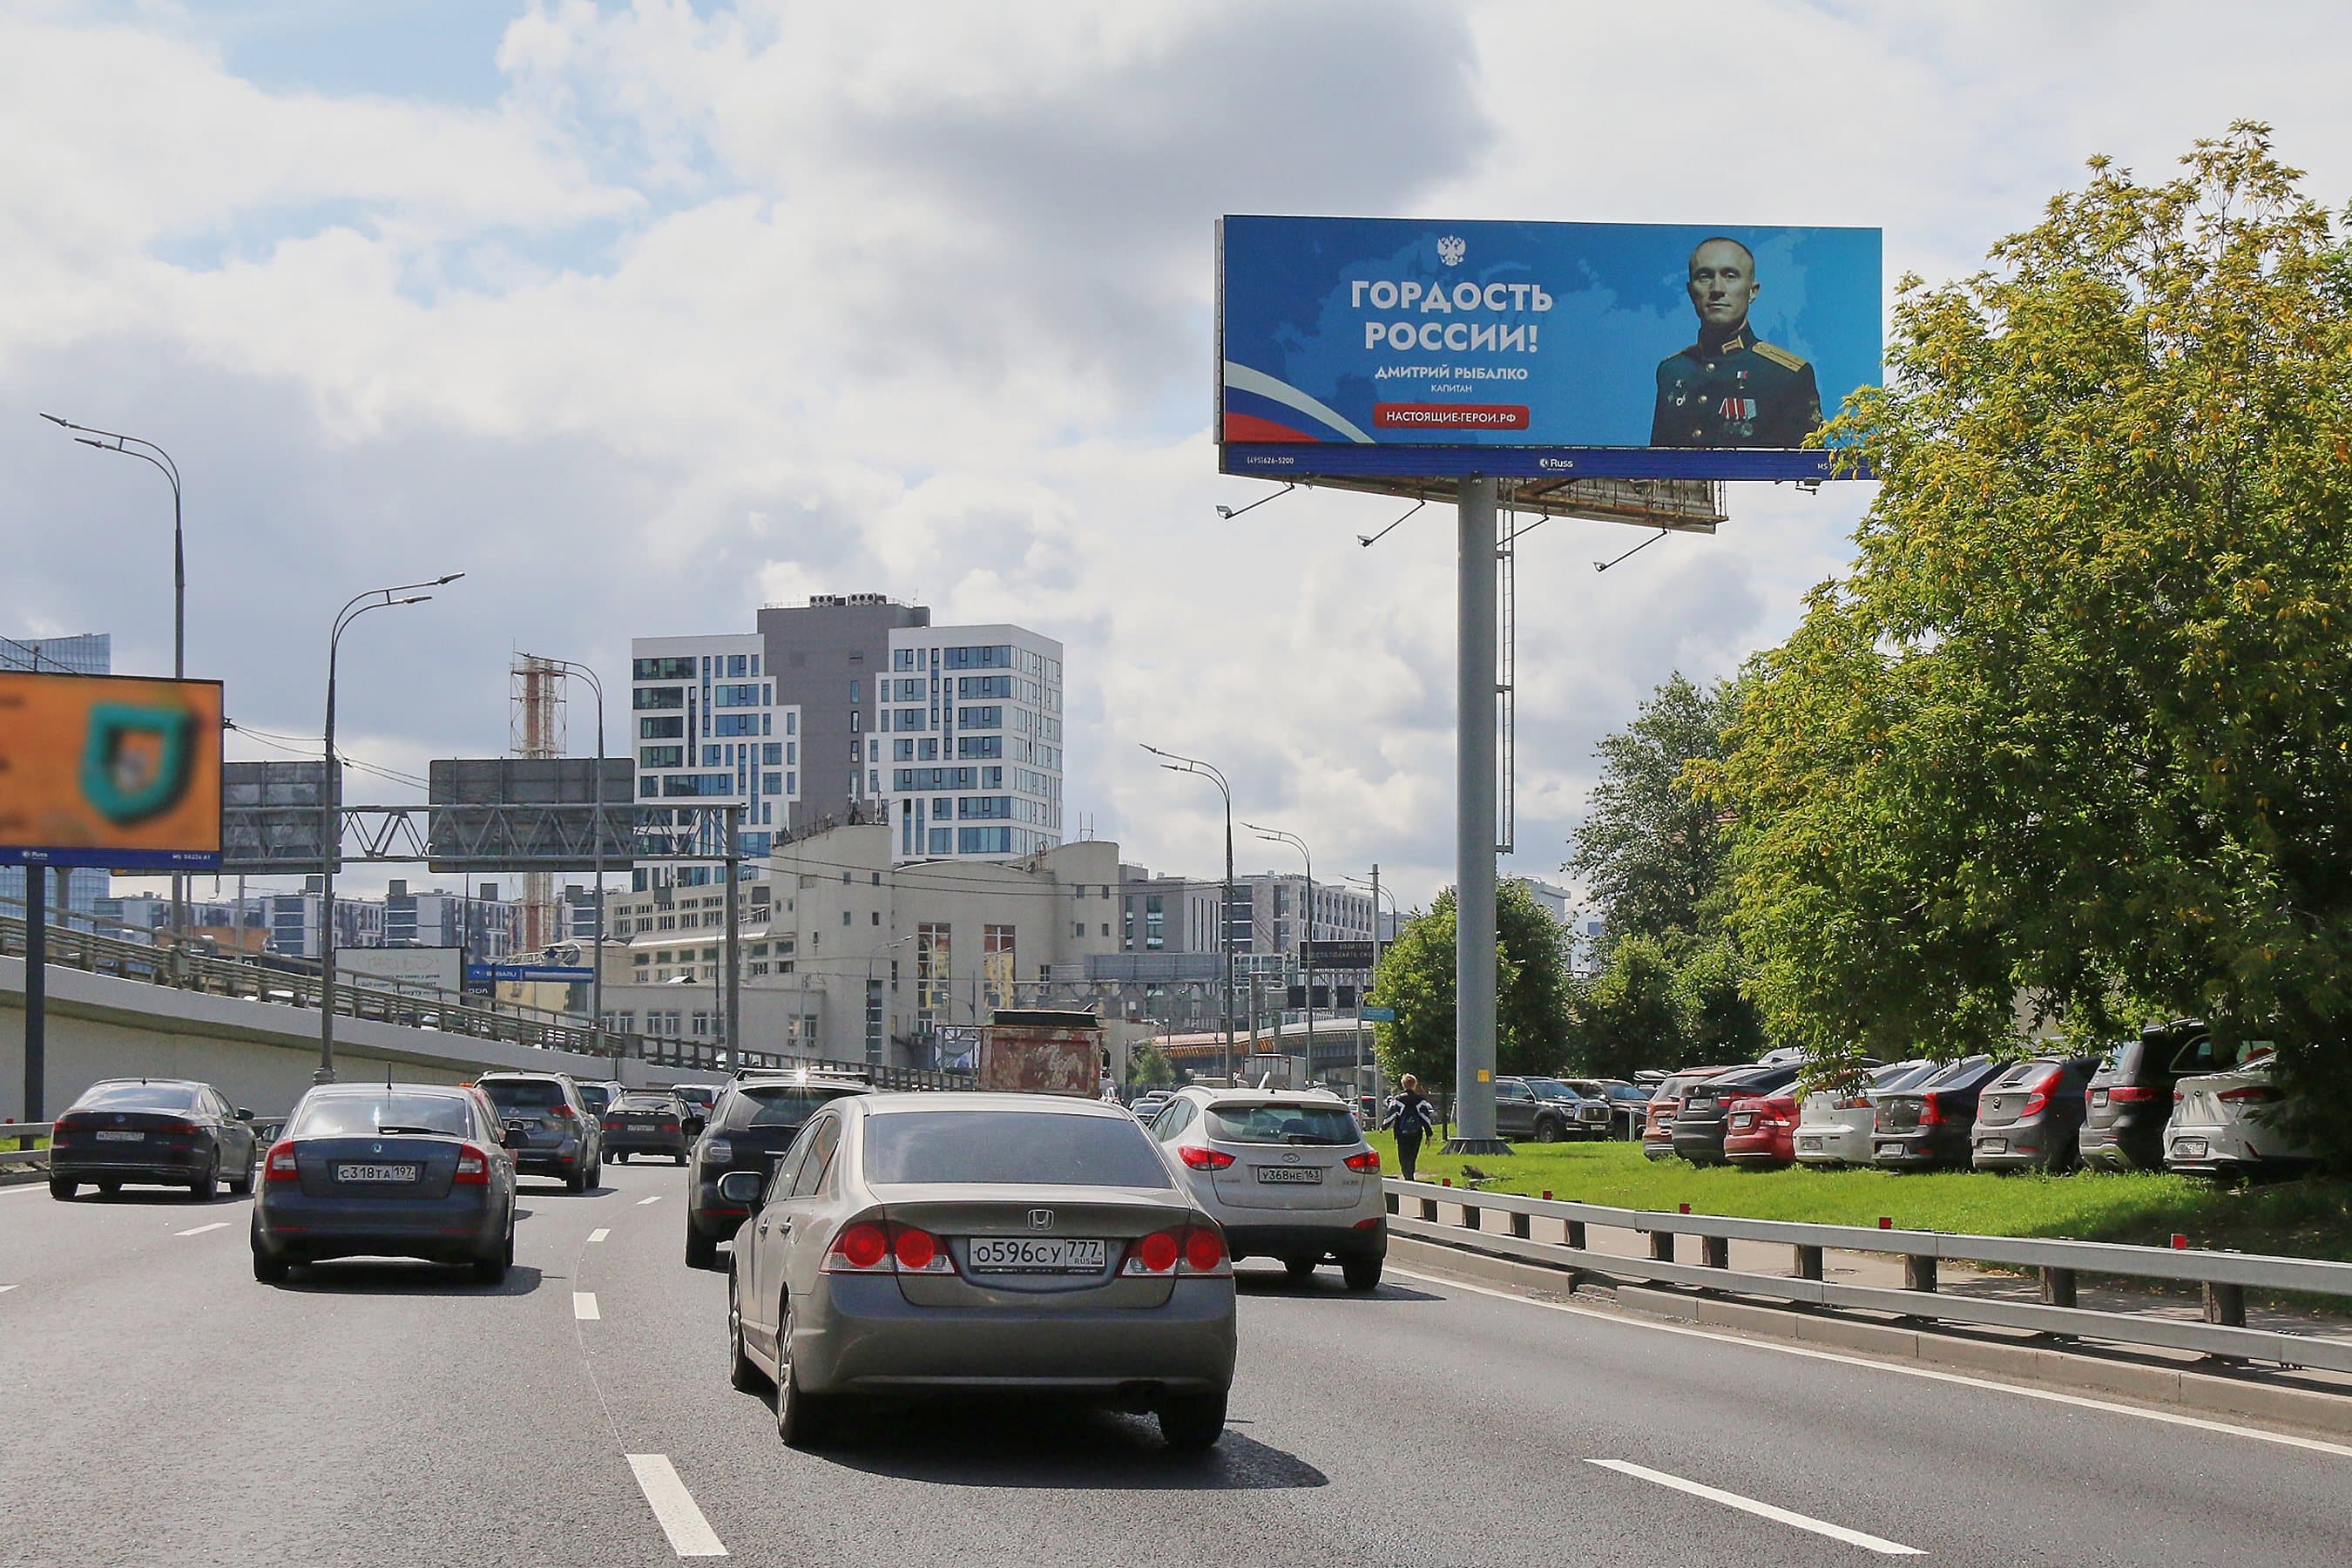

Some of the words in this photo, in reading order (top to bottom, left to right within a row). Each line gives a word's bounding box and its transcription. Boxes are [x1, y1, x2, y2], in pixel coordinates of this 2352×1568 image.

[1352, 280, 1553, 314] ГОРДОСТЬ
[1365, 321, 1538, 354] РОССИИ!
[1375, 364, 1450, 379] ДМИТРИЙ
[1454, 368, 1529, 381] РЫБАЛКО
[1430, 384, 1472, 393] КАПИТАН
[1386, 411, 1517, 423] НАСТОЯЩИЕ-ГЕРОИ.РФ
[1551, 458, 1573, 468] Russ
[341, 1166, 391, 1179] С318ТА
[394, 1166, 413, 1176] 197
[1262, 1170, 1302, 1180] У368НЕ
[1304, 1170, 1319, 1179] 163
[977, 1241, 1062, 1263] О596СУ
[1067, 1241, 1098, 1258] 777
